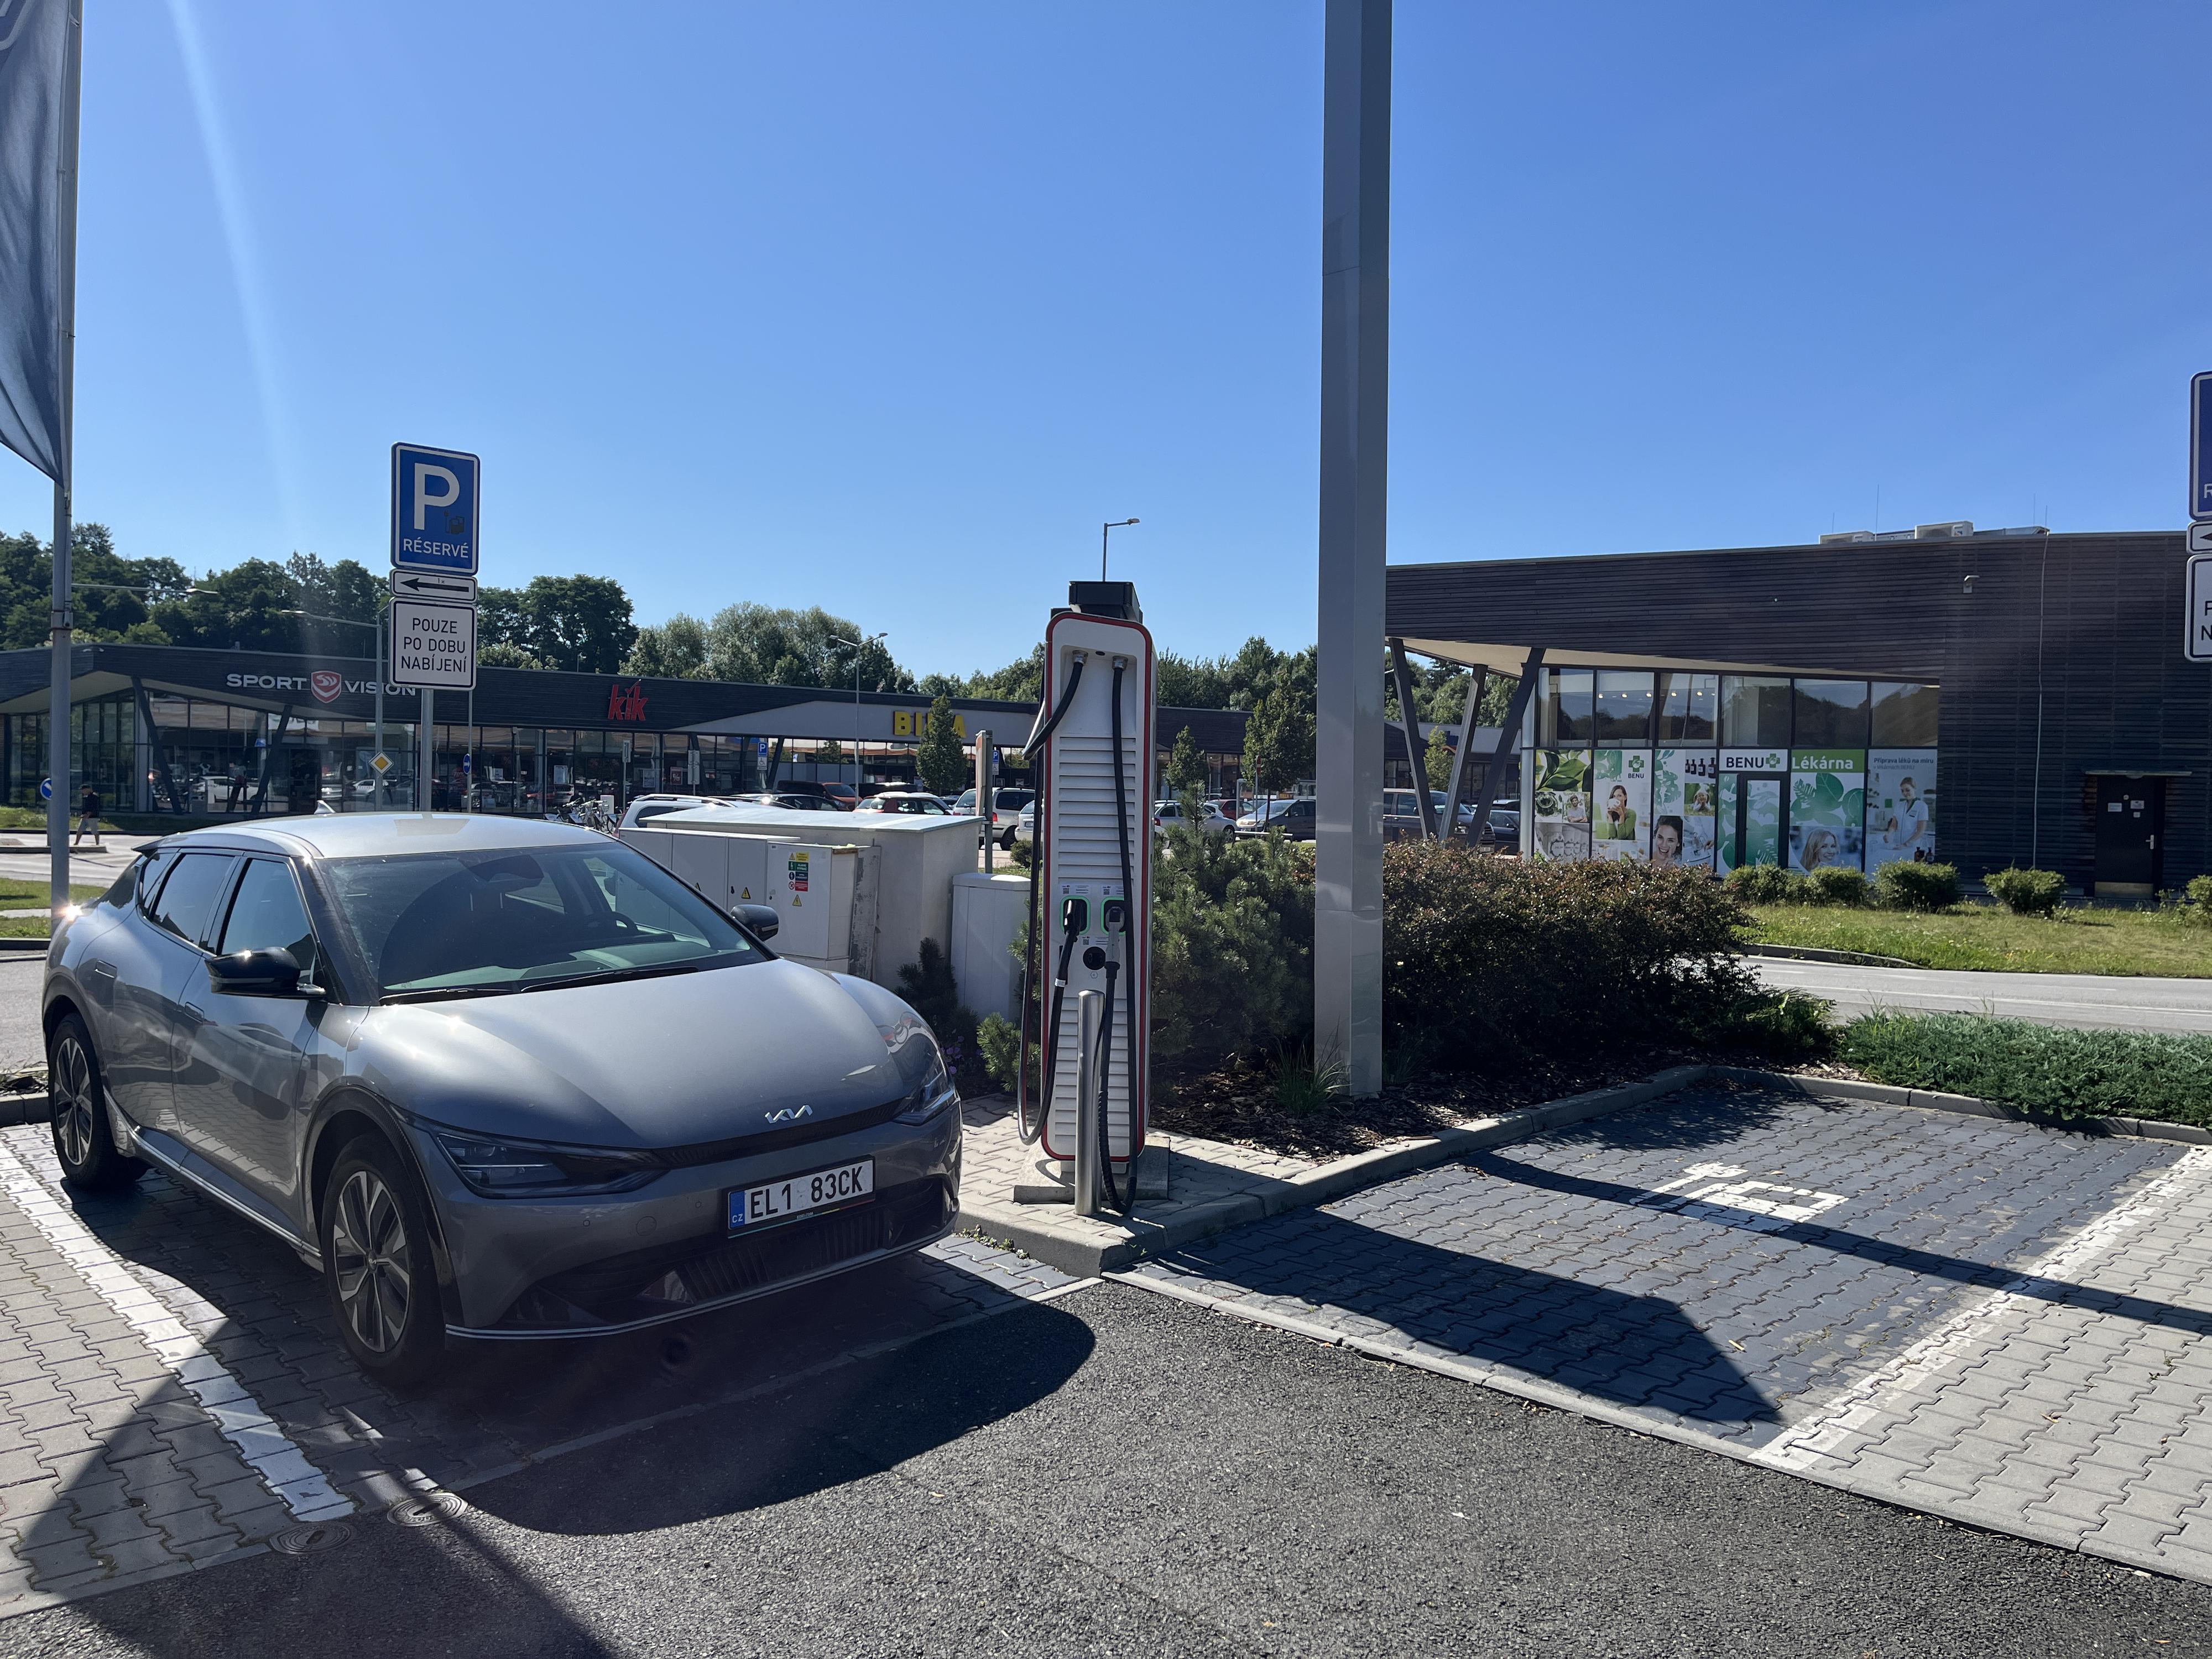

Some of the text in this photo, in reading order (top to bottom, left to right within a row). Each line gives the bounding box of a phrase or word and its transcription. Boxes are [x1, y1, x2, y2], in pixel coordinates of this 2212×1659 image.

[414, 463, 460, 530] P
[403, 536, 469, 559] RÉSERVÉ
[413, 618, 457, 634] POUZE
[404, 637, 466, 653] PO DOBU
[401, 654, 467, 673] NABÍJENÍ
[226, 673, 307, 691] SPORT
[1726, 757, 1764, 768] BENU
[1792, 755, 1853, 769] Lékárna
[732, 1166, 863, 1223] CZ EL1 83CK
